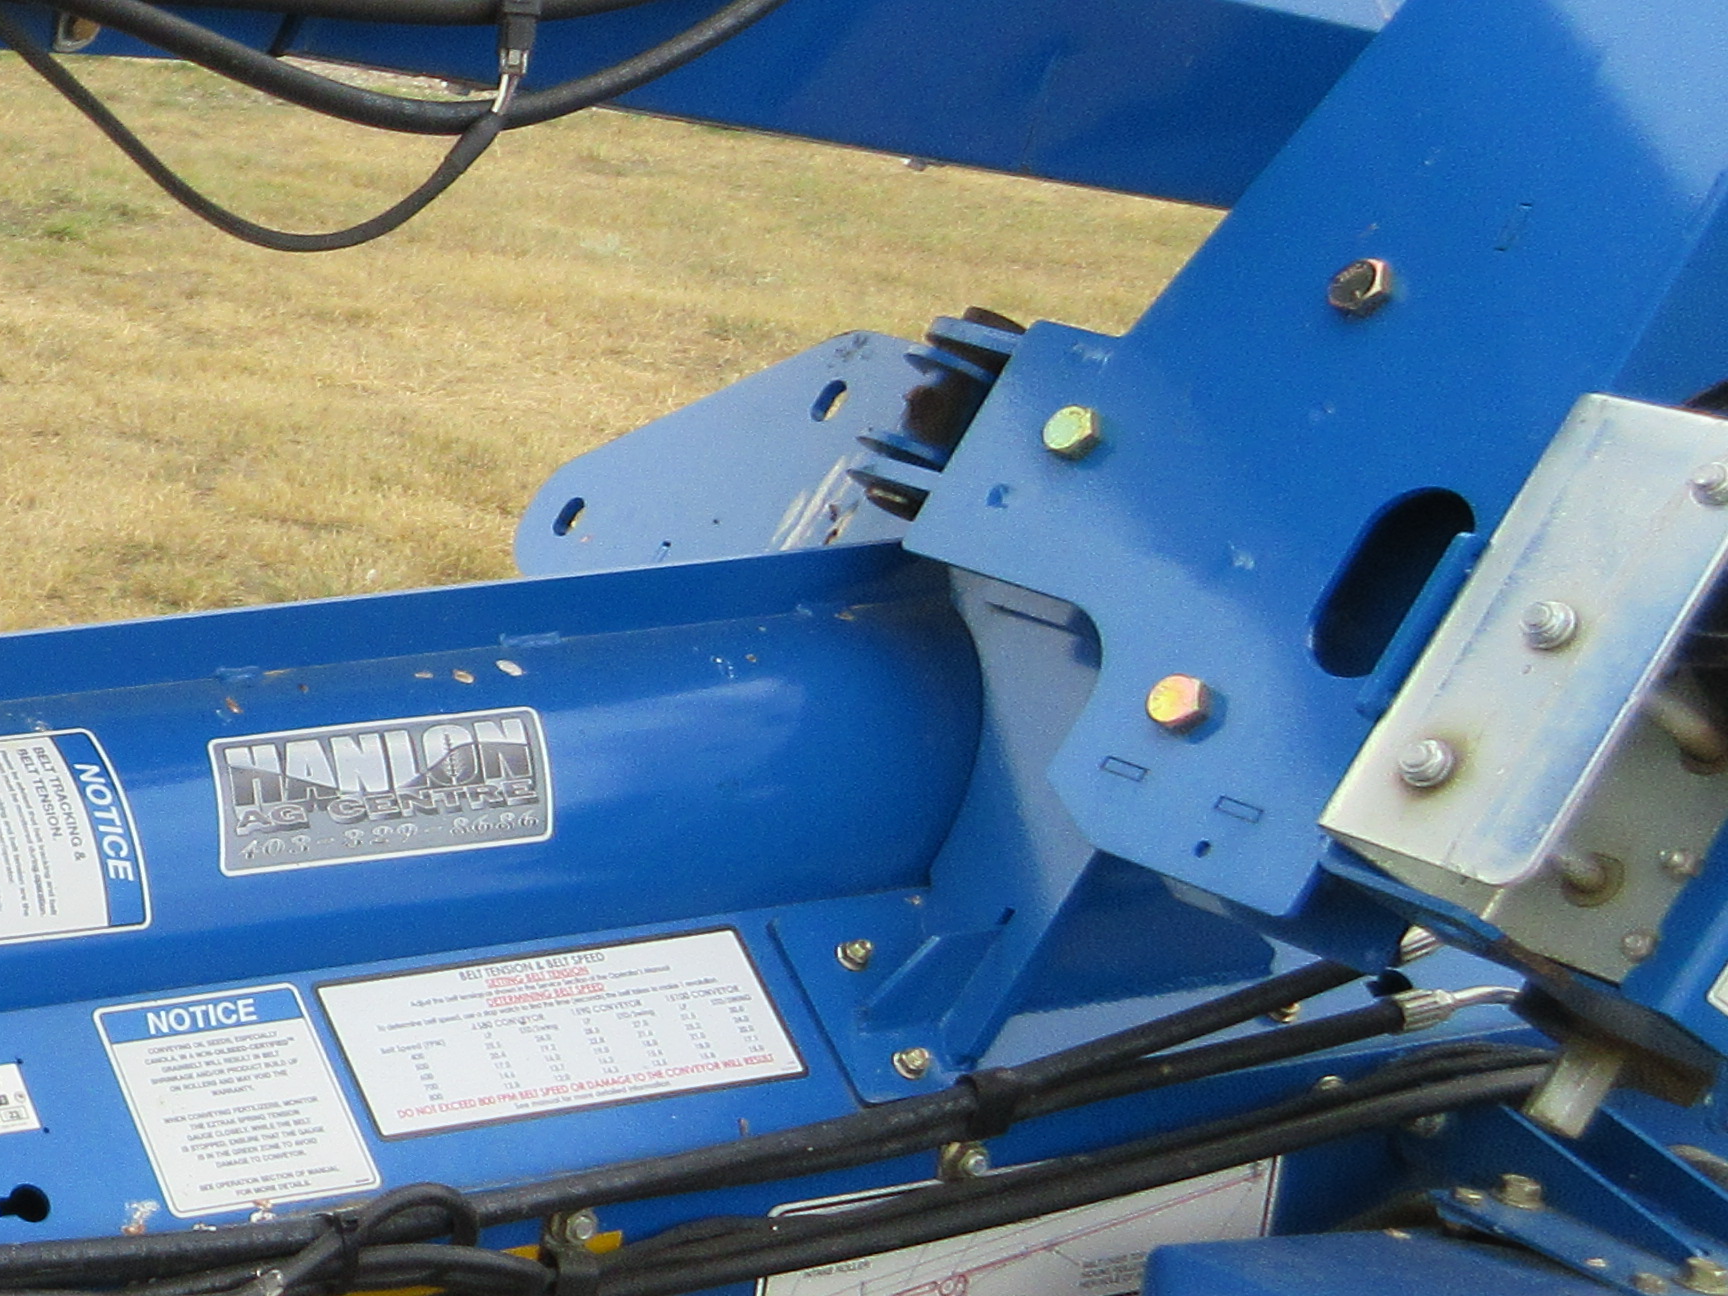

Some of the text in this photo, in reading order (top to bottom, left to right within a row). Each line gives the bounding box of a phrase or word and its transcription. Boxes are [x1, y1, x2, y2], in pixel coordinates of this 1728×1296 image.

[14, 748, 40, 776] BELT
[225, 718, 532, 811] HANLON
[31, 746, 86, 861] BELT TRACKING &
[73, 763, 135, 882] NOTICE
[234, 776, 538, 835] AG CENTRE
[457, 968, 483, 981] BELT
[483, 961, 534, 977] TENSION
[545, 956, 571, 968] BELT
[569, 951, 606, 965] SPEED
[146, 999, 257, 1035] NOTICE
[585, 1075, 632, 1089] DAMAGE
[631, 1072, 648, 1082] TO
[664, 1061, 722, 1078] CONVEYOR
